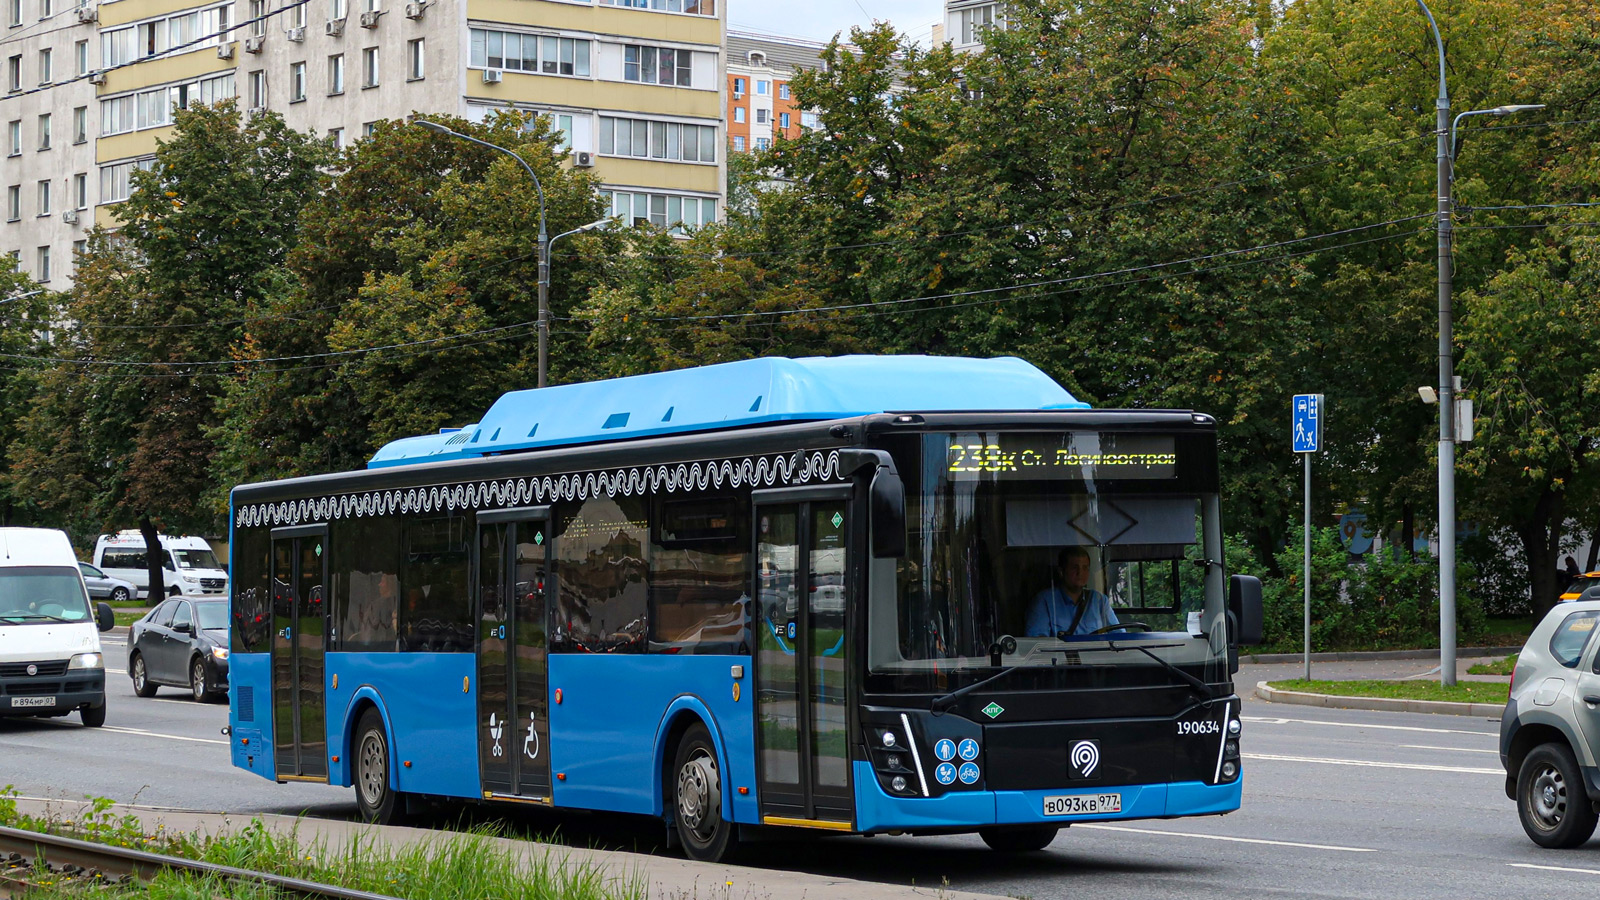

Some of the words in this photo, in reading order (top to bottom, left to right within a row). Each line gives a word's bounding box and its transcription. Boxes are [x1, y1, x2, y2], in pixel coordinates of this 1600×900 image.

[1177, 720, 1220, 735] 190634
[1048, 797, 1098, 813] В093КВ
[1099, 795, 1118, 807] 977
